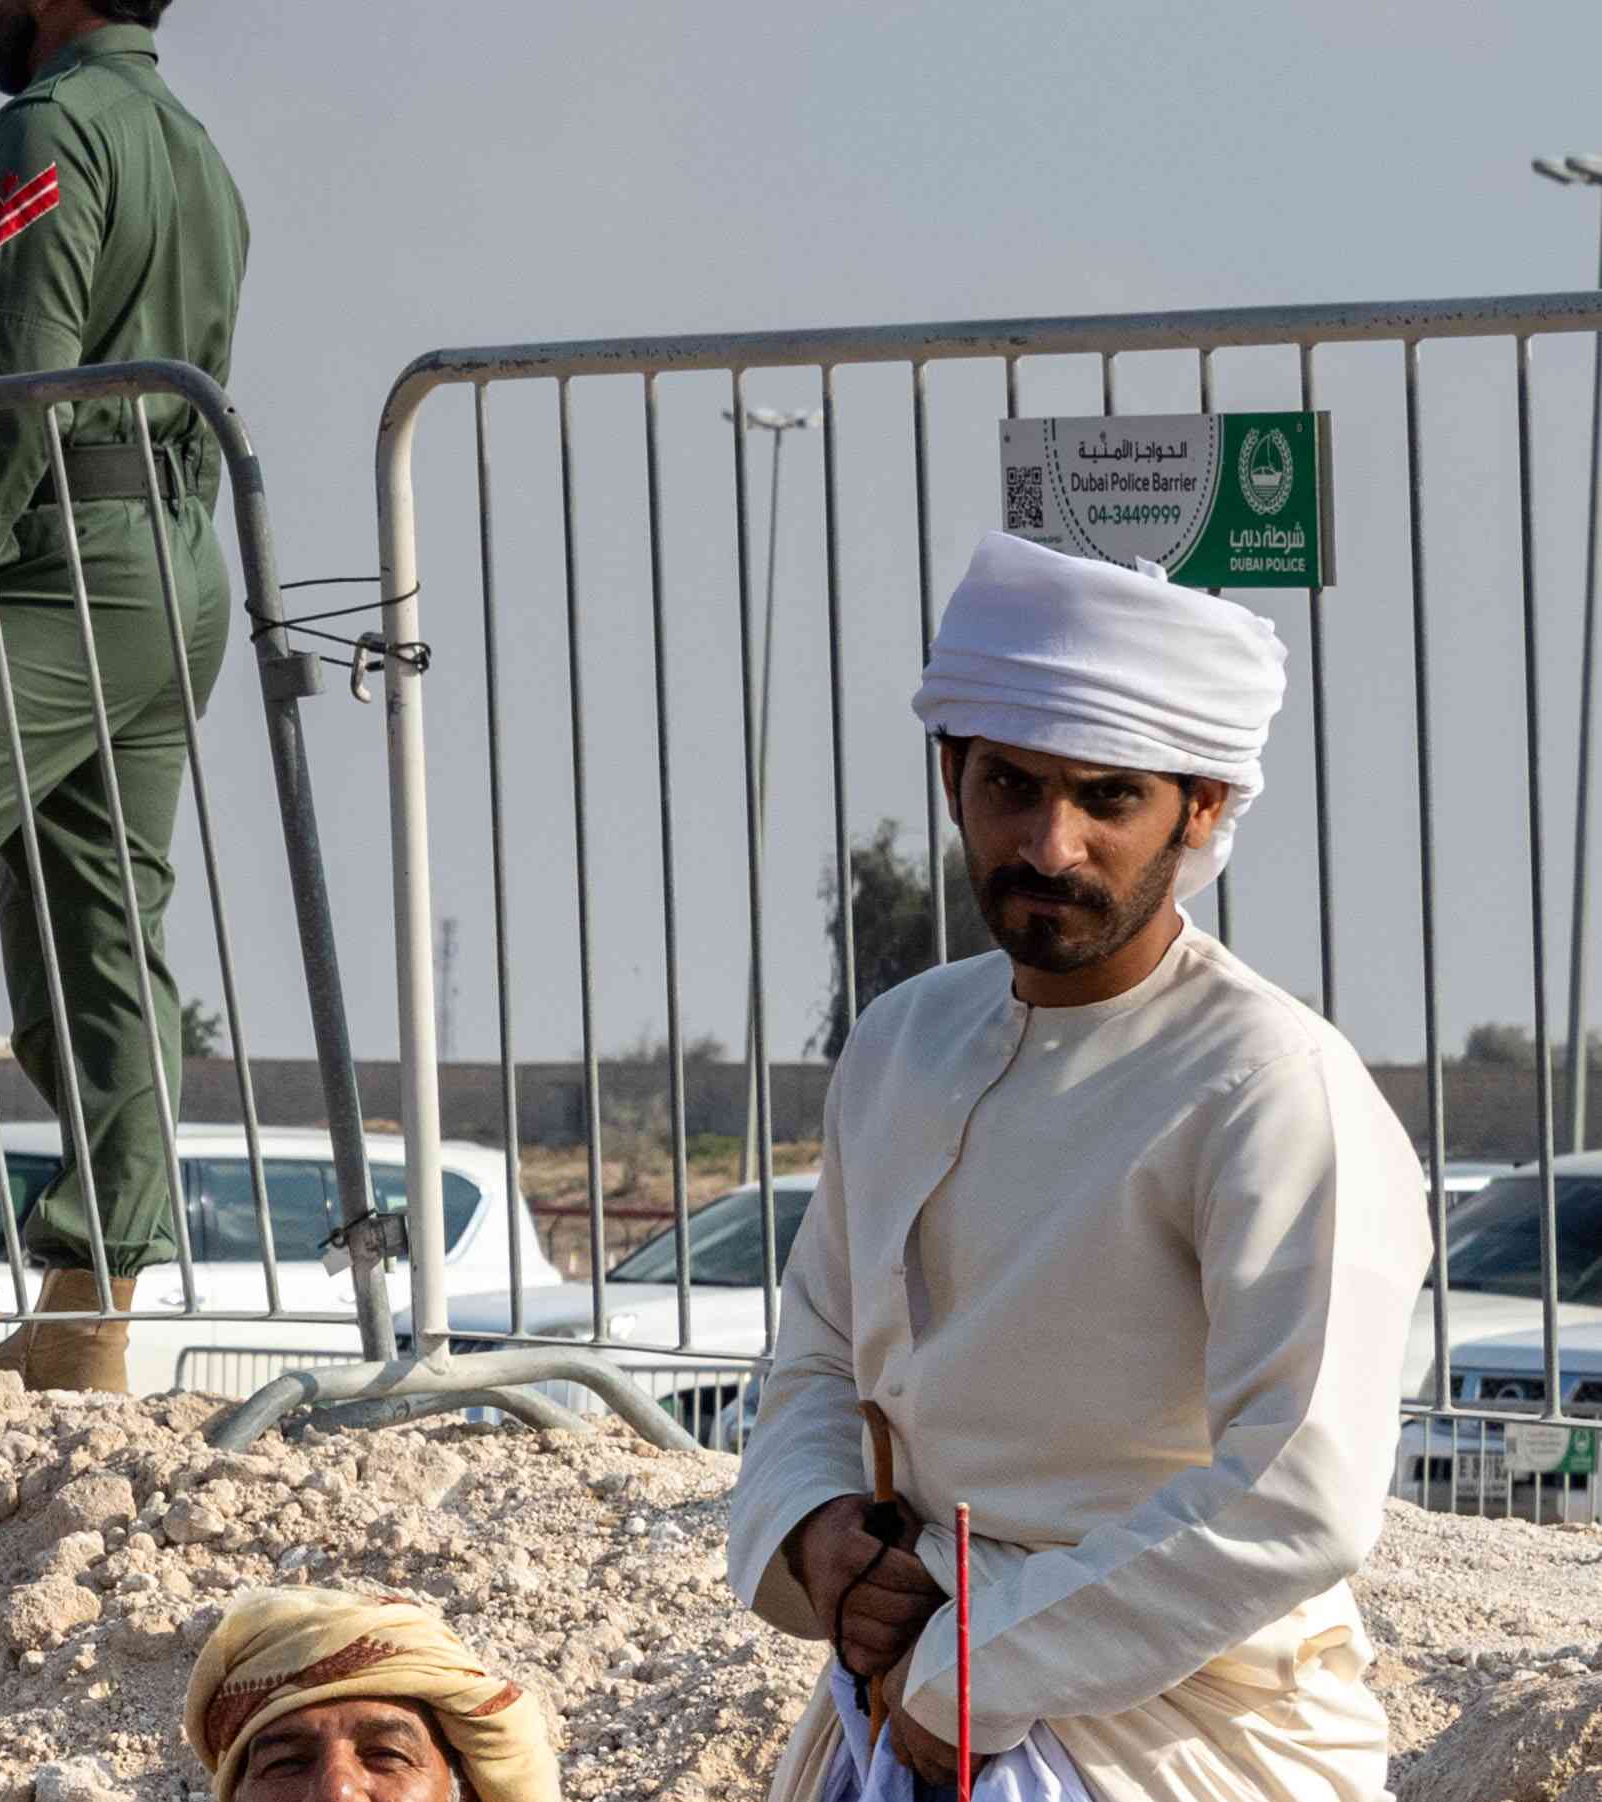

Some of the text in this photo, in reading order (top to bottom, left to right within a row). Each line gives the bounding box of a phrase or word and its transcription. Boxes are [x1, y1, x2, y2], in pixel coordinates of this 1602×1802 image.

[1079, 439, 1187, 464] الحواجز الأمنية
[1071, 472, 1197, 491] Dubai Police Barrier
[1088, 504, 1181, 524] 04-3449999
[1230, 521, 1305, 554] شرطة دبي
[1230, 557, 1306, 572] DUBAI POLICE
